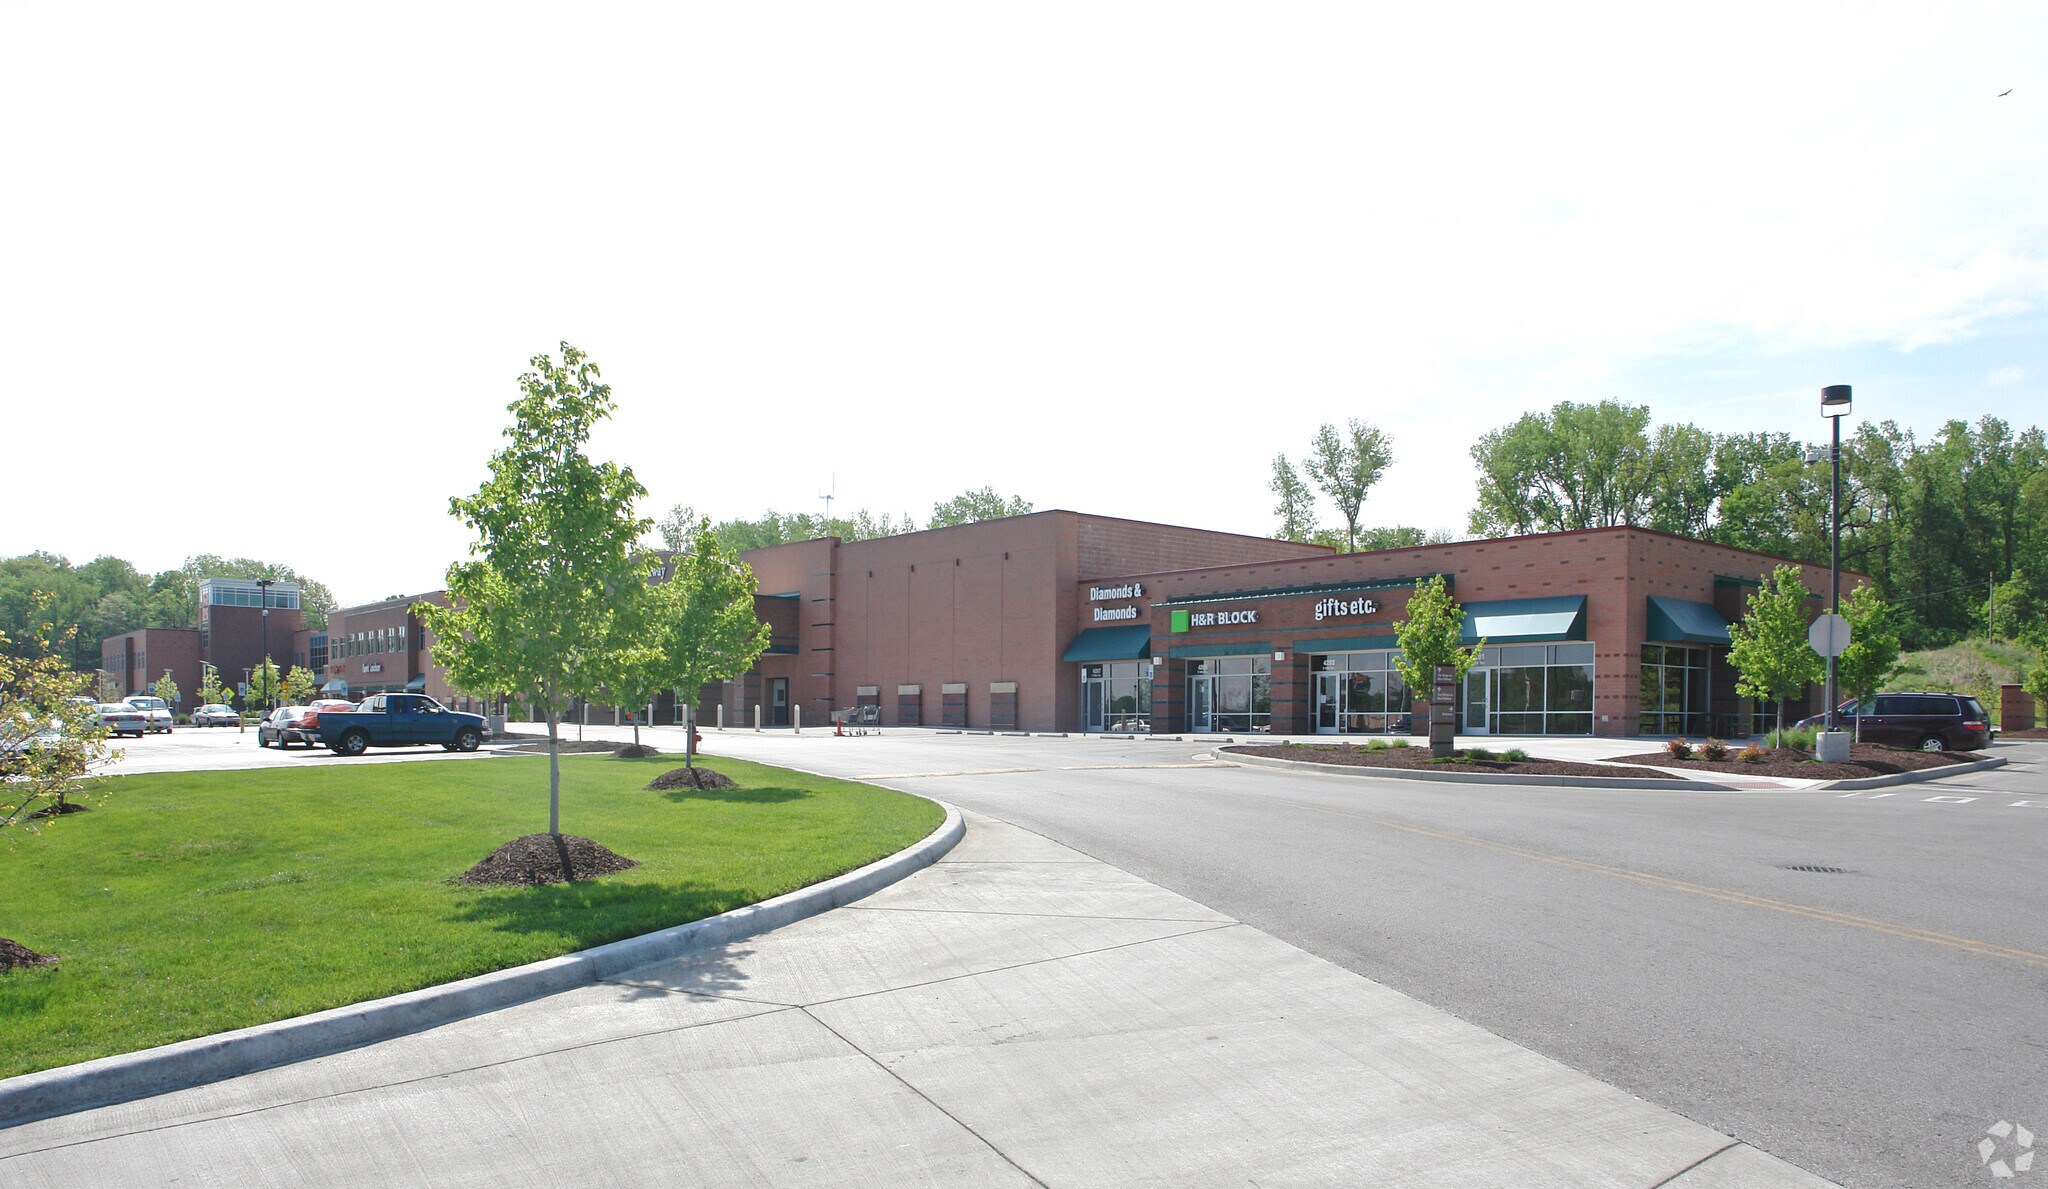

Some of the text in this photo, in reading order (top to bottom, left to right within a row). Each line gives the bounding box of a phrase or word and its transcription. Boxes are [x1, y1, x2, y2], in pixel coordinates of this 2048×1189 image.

[1090, 582, 1142, 601] Diamonds &
[1094, 605, 1137, 621] Diamonds
[1315, 597, 1376, 621] gifts etc.
[1191, 610, 1256, 626] H&R BLOCK
